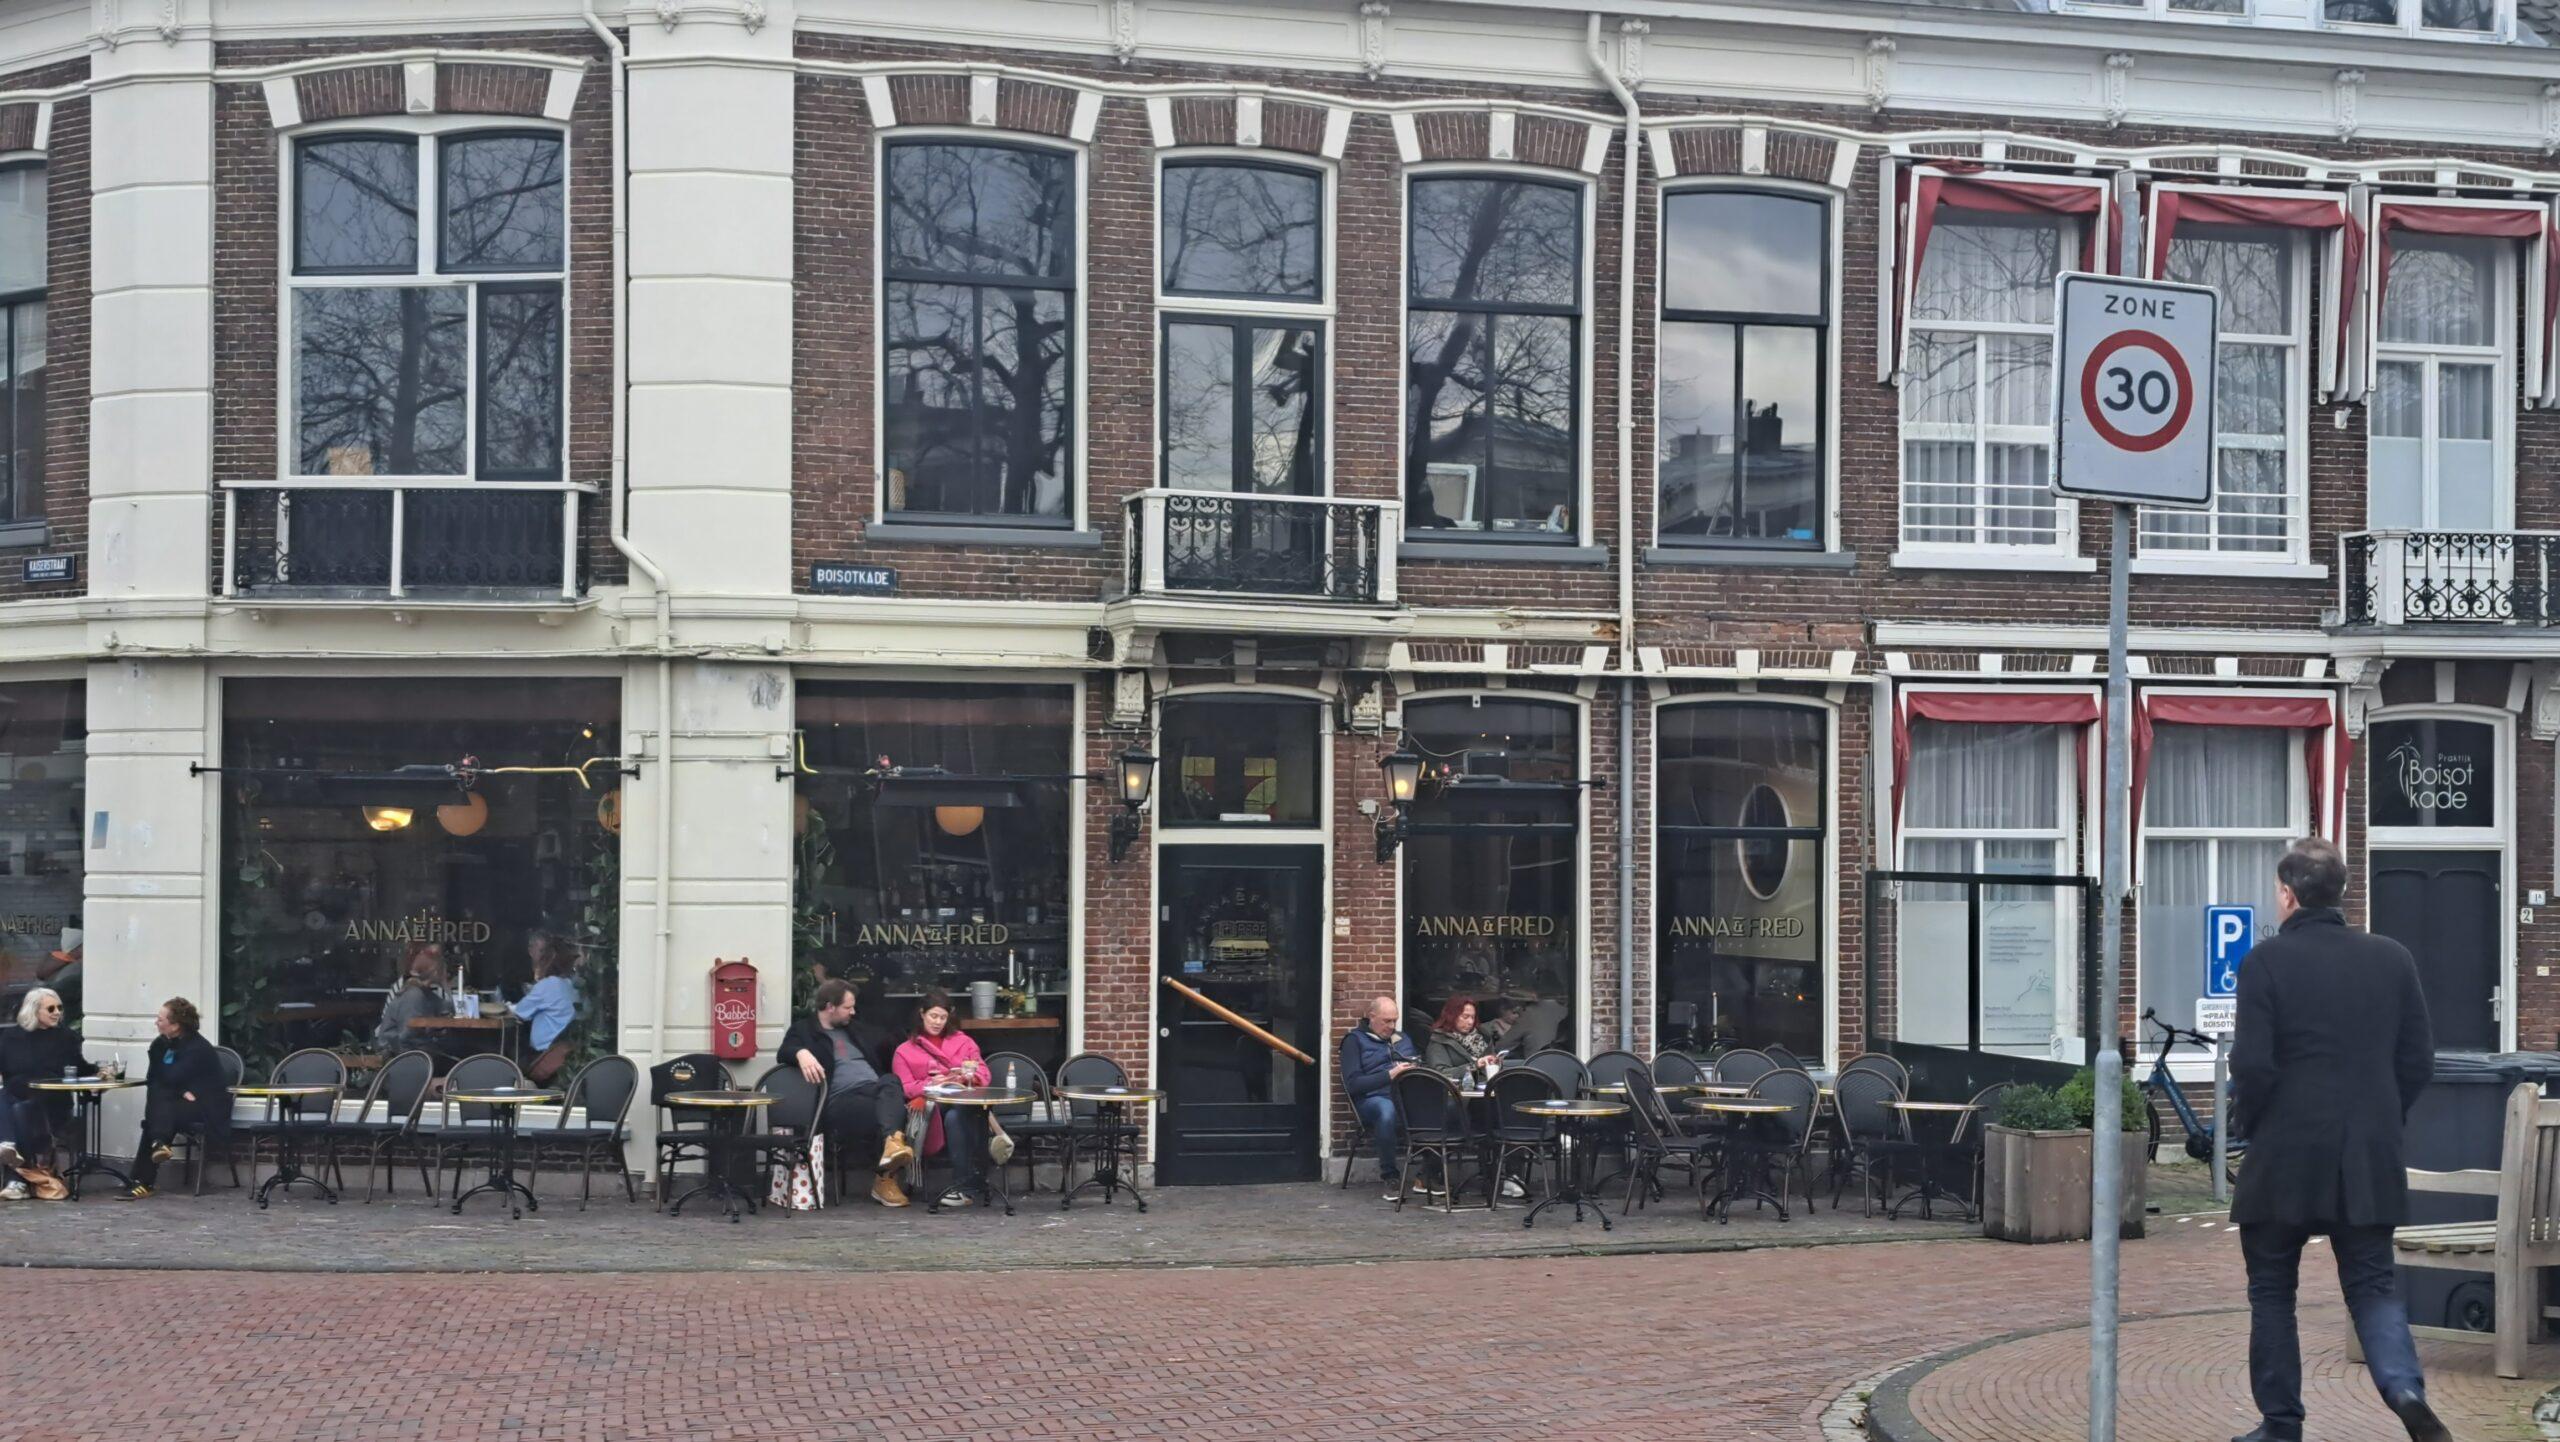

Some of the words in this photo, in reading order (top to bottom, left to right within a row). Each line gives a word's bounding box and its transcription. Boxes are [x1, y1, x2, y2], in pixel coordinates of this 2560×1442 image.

[2104, 294, 2175, 319] ZONE
[2103, 366, 2170, 415] 30
[817, 568, 889, 585] BOISOTKADE
[2410, 759, 2474, 785] Boisot
[2409, 784, 2467, 809] kade
[2523, 909, 2531, 922] 2
[2218, 914, 2243, 959] P
[715, 1003, 755, 1020] Babbels
[2208, 1012, 2236, 1020] PRAKT
